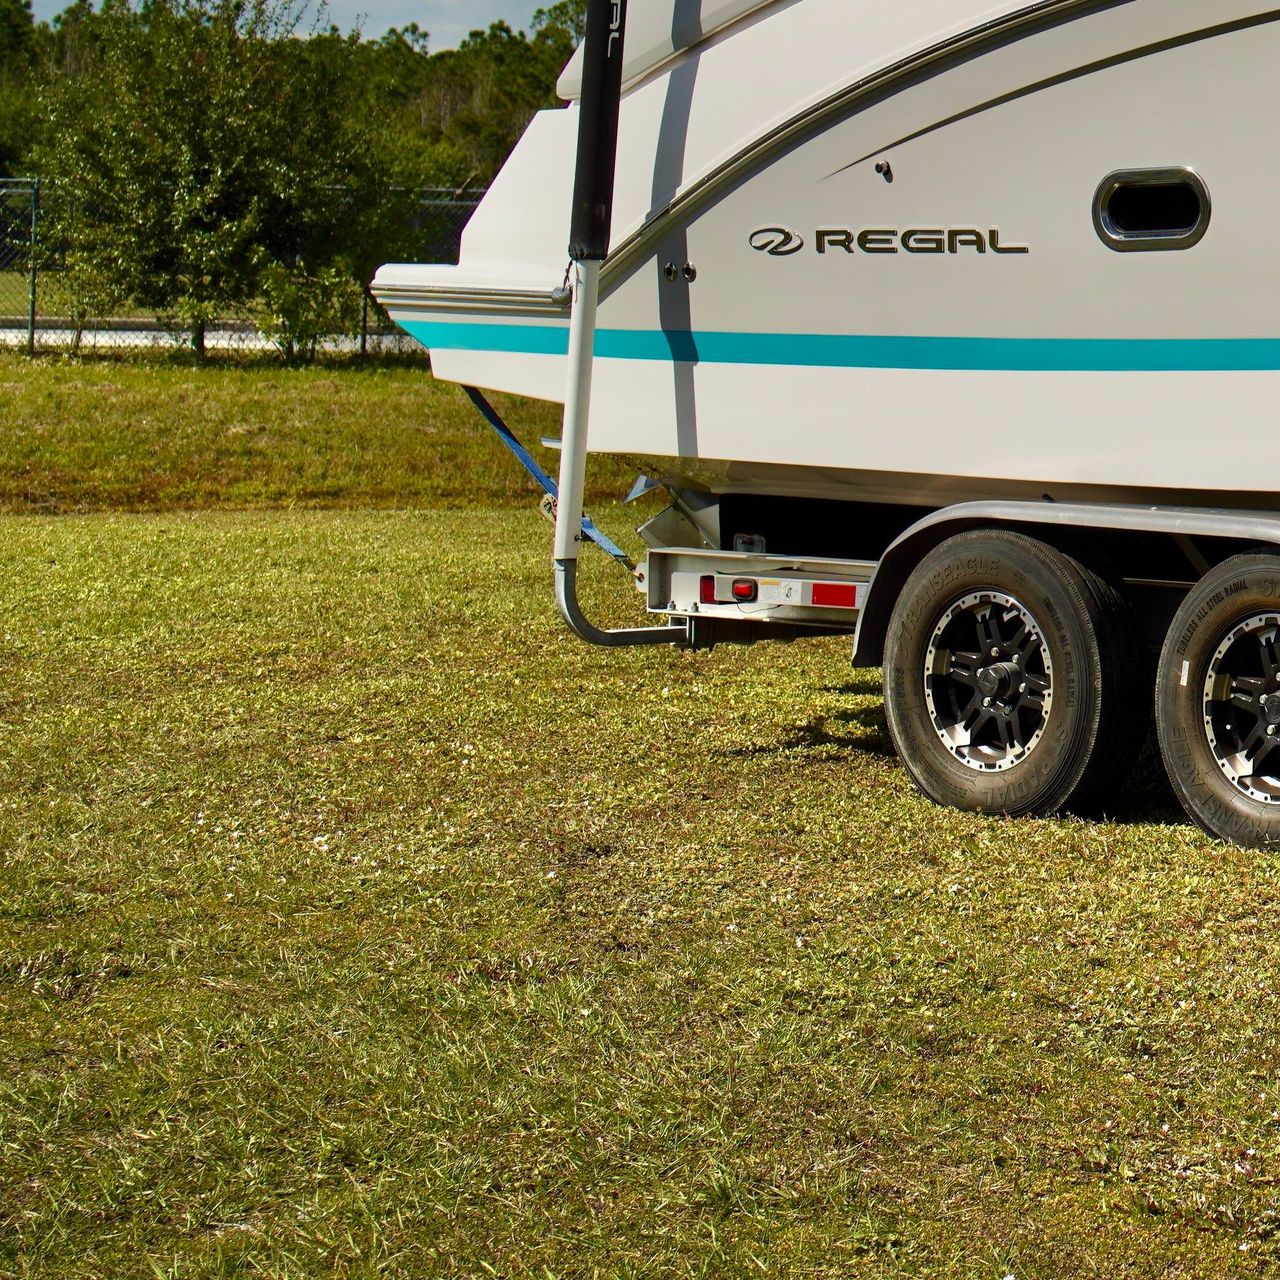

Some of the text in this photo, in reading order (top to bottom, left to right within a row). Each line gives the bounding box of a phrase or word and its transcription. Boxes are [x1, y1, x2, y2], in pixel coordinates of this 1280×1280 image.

[815, 226, 1029, 254] REGAL
[1177, 618, 1199, 656] TUBELESS
[1195, 607, 1209, 623] ALL
[1206, 592, 1225, 611] STEEL
[1223, 578, 1249, 597] RADIAL
